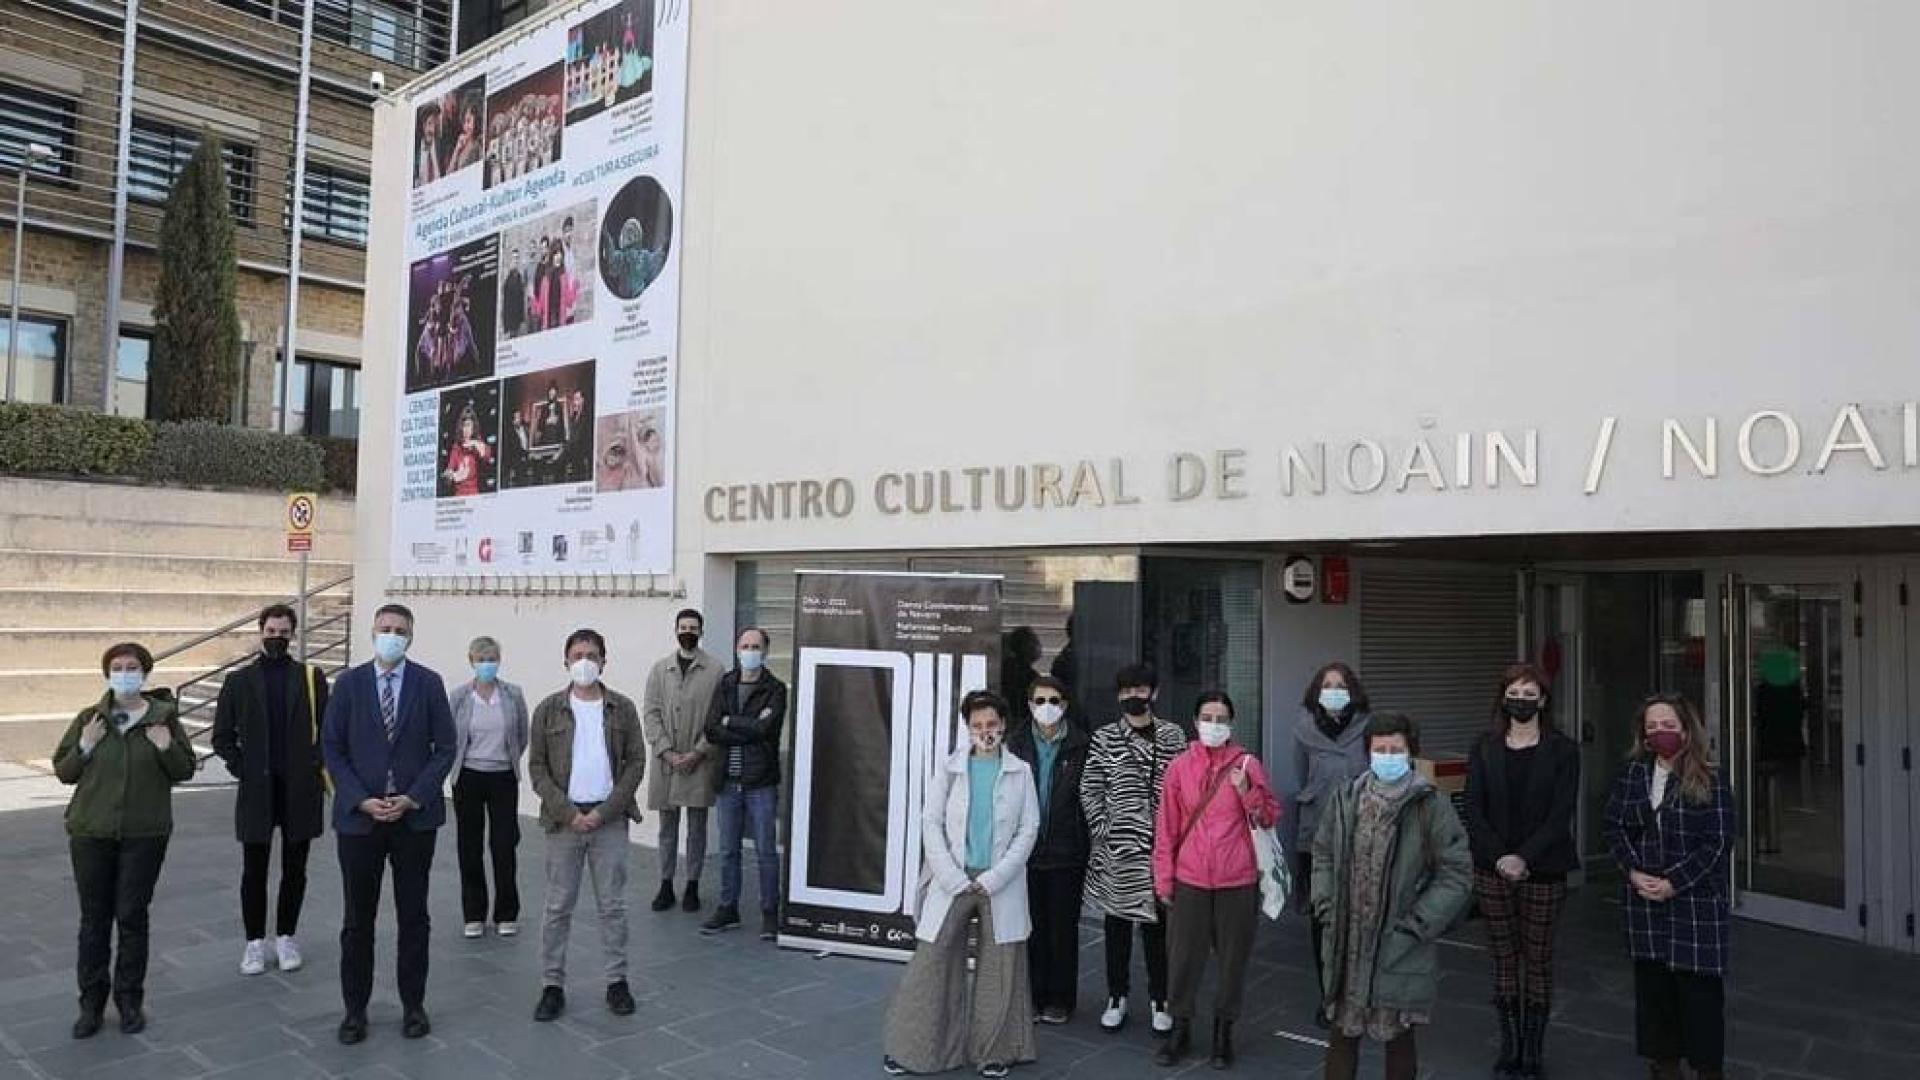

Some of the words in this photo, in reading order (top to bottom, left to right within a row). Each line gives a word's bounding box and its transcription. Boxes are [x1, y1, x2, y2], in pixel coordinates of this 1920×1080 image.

[524, 168, 566, 198] Agenda
[703, 477, 856, 523] CENTRO
[875, 458, 1141, 514] CULTURAL
[1167, 449, 1247, 502] DE
